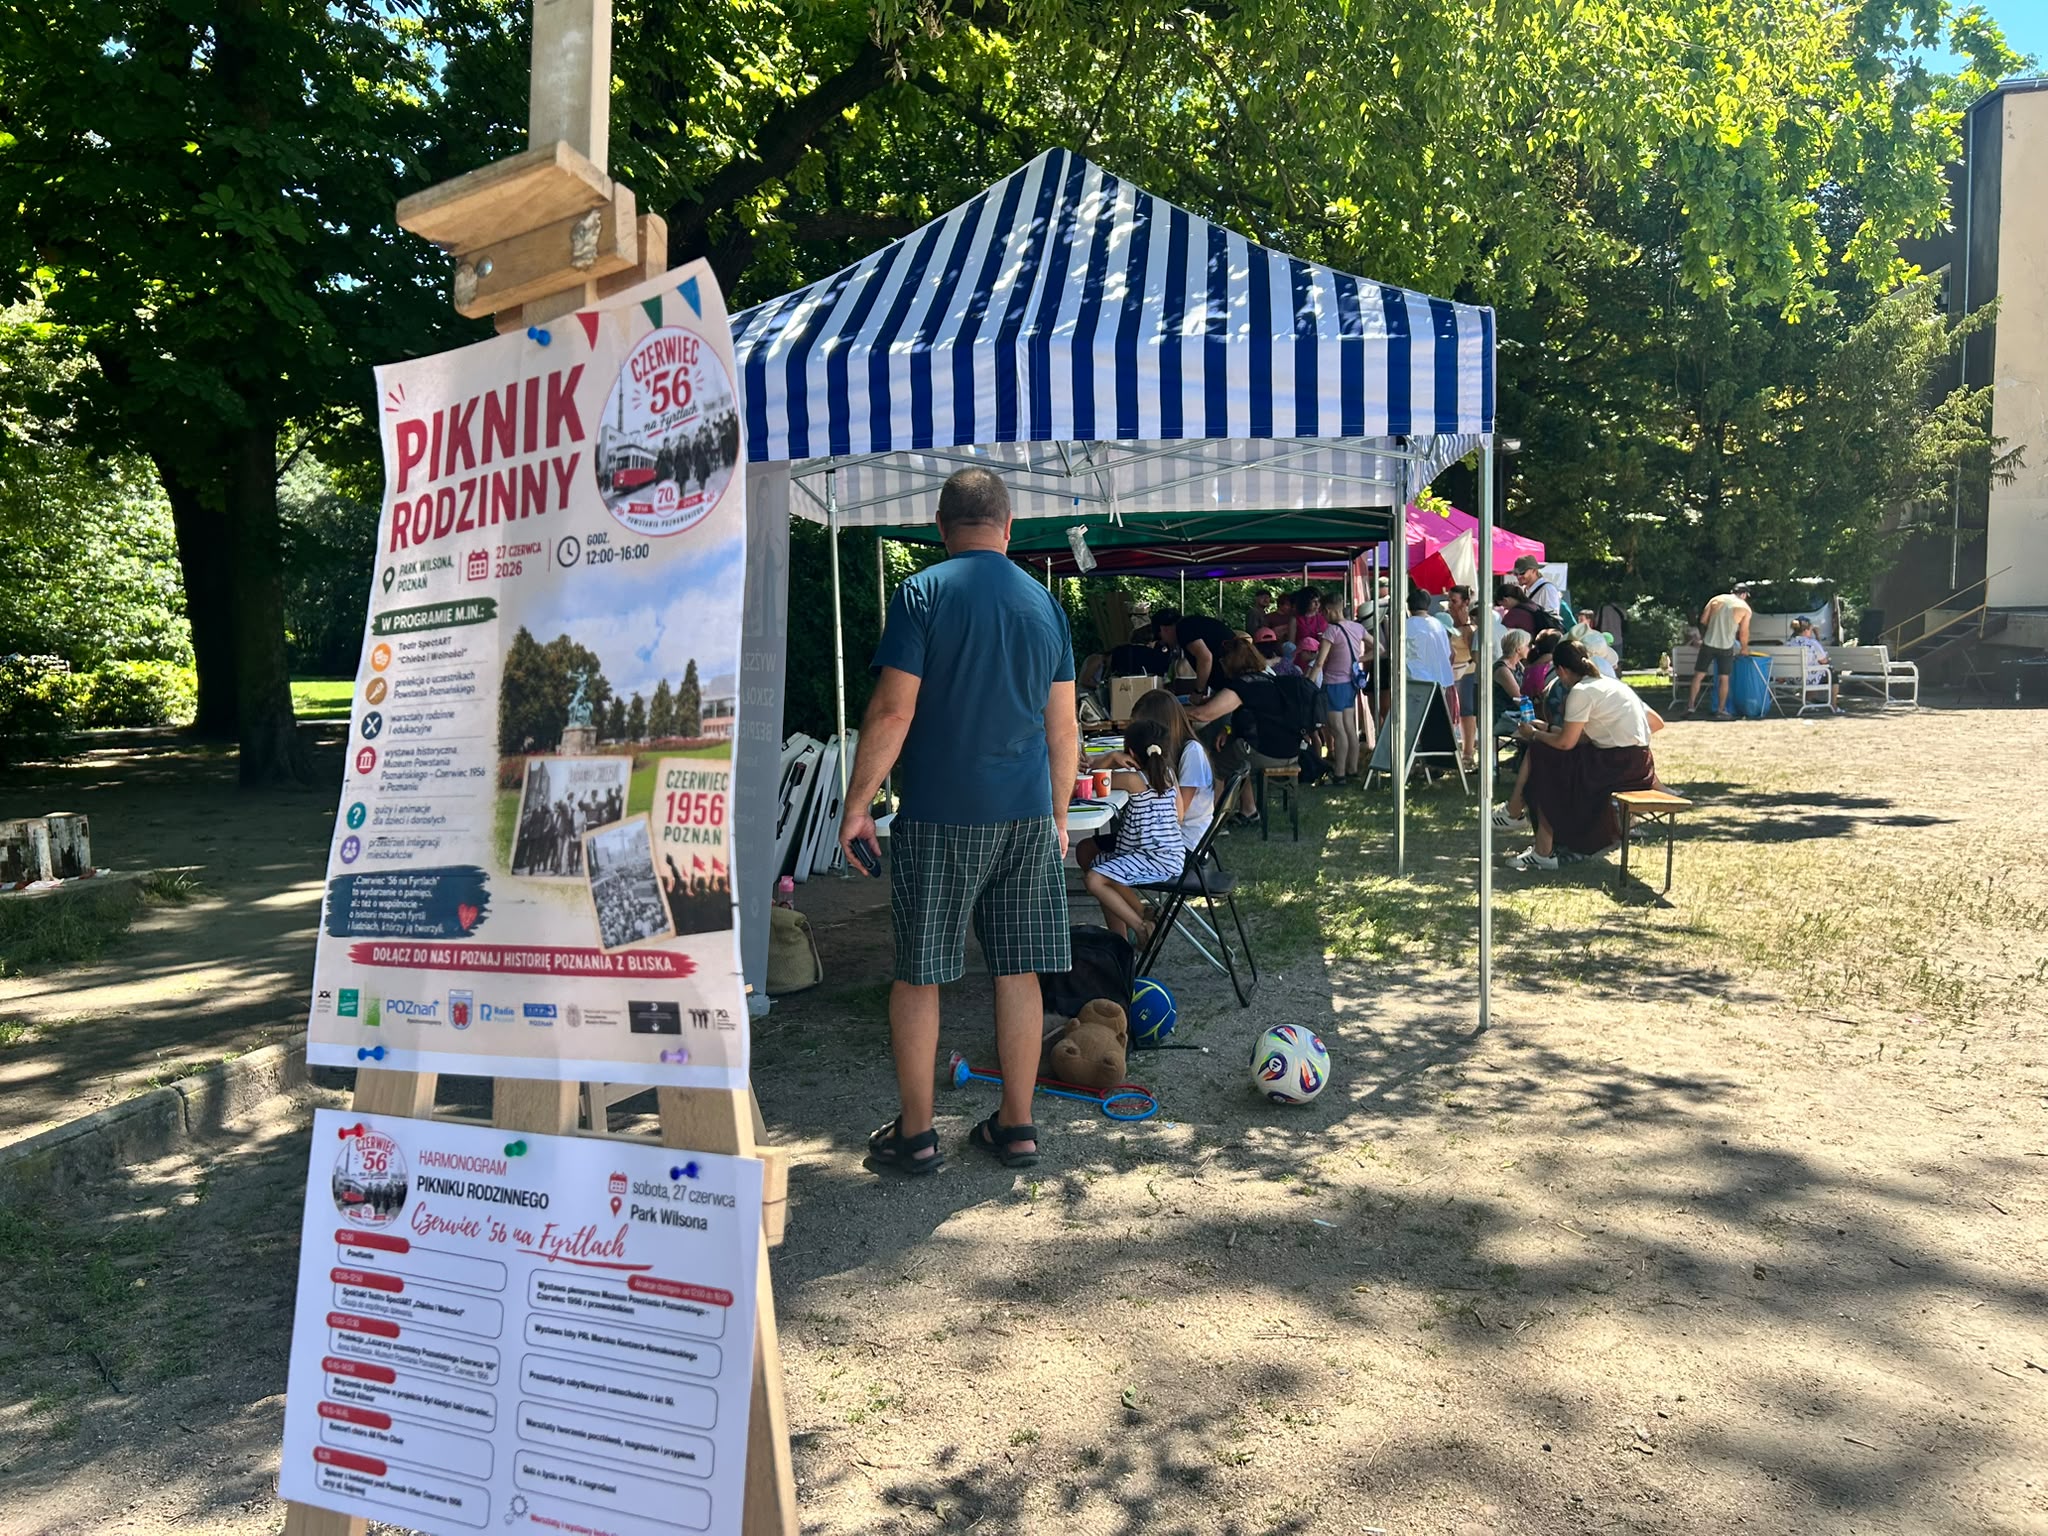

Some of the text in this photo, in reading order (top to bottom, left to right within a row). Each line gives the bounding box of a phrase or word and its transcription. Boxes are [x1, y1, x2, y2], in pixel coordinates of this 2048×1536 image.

[631, 335, 699, 383] CZERWIEC
[644, 420, 657, 432] na
[659, 401, 698, 430] Fyrtlach
[396, 363, 585, 494] PIKNIK
[390, 452, 581, 552] RODZINNY
[658, 487, 675, 504] 70.
[587, 532, 610, 546] GODZ.
[496, 542, 542, 559] 27 CZERWCA
[399, 561, 417, 576] PARK
[495, 561, 523, 578] 2026
[397, 573, 428, 592] POZNAŃ
[381, 617, 391, 631] W
[393, 608, 453, 629] PROGRAMIE
[432, 669, 475, 683] uczestnikach
[394, 685, 475, 698] Powstania Poznańskiego
[391, 710, 455, 722] warsztaty rodzinne
[393, 725, 432, 736] edukacyjne
[385, 749, 415, 758] wystawa
[383, 757, 450, 768] Muzeum Powstania
[381, 766, 486, 781] Poznańskiego Czerwiec 1956
[665, 769, 728, 791] CZERWIEC
[386, 782, 418, 791] Poznaniu
[399, 804, 431, 814] animacje
[666, 791, 725, 826] 1956
[372, 815, 384, 824] dla
[385, 815, 404, 824] dzieci
[410, 815, 446, 826] dorosłych
[406, 836, 441, 848] integracji
[663, 824, 722, 845] POZNAŃ
[367, 850, 413, 859] mieszkańców
[360, 888, 397, 898] wydarzenie
[379, 899, 418, 909] wspólnocie
[378, 912, 407, 921] naszych
[381, 922, 403, 933] którzy
[373, 947, 411, 965] DOŁĄCZ
[413, 949, 428, 963] DO
[429, 950, 451, 964] NAS
[460, 951, 501, 967] POZNAJ
[503, 952, 551, 971] HISTORIĘ
[554, 953, 613, 970] POZNANIA
[615, 956, 625, 970] Z
[628, 956, 677, 971] BLISKA.
[356, 1136, 396, 1156] CZERWIEC
[419, 1151, 507, 1176] HARMONOGRAM
[417, 1175, 549, 1210] PIKNIKU RODZINNEGO
[633, 1180, 736, 1208] sobota, 27 czerwca
[630, 1204, 708, 1231] Park Wilsona
[411, 1201, 482, 1238] Czerwiec
[513, 1228, 535, 1246] na
[539, 1222, 629, 1263] Fyrtlach
